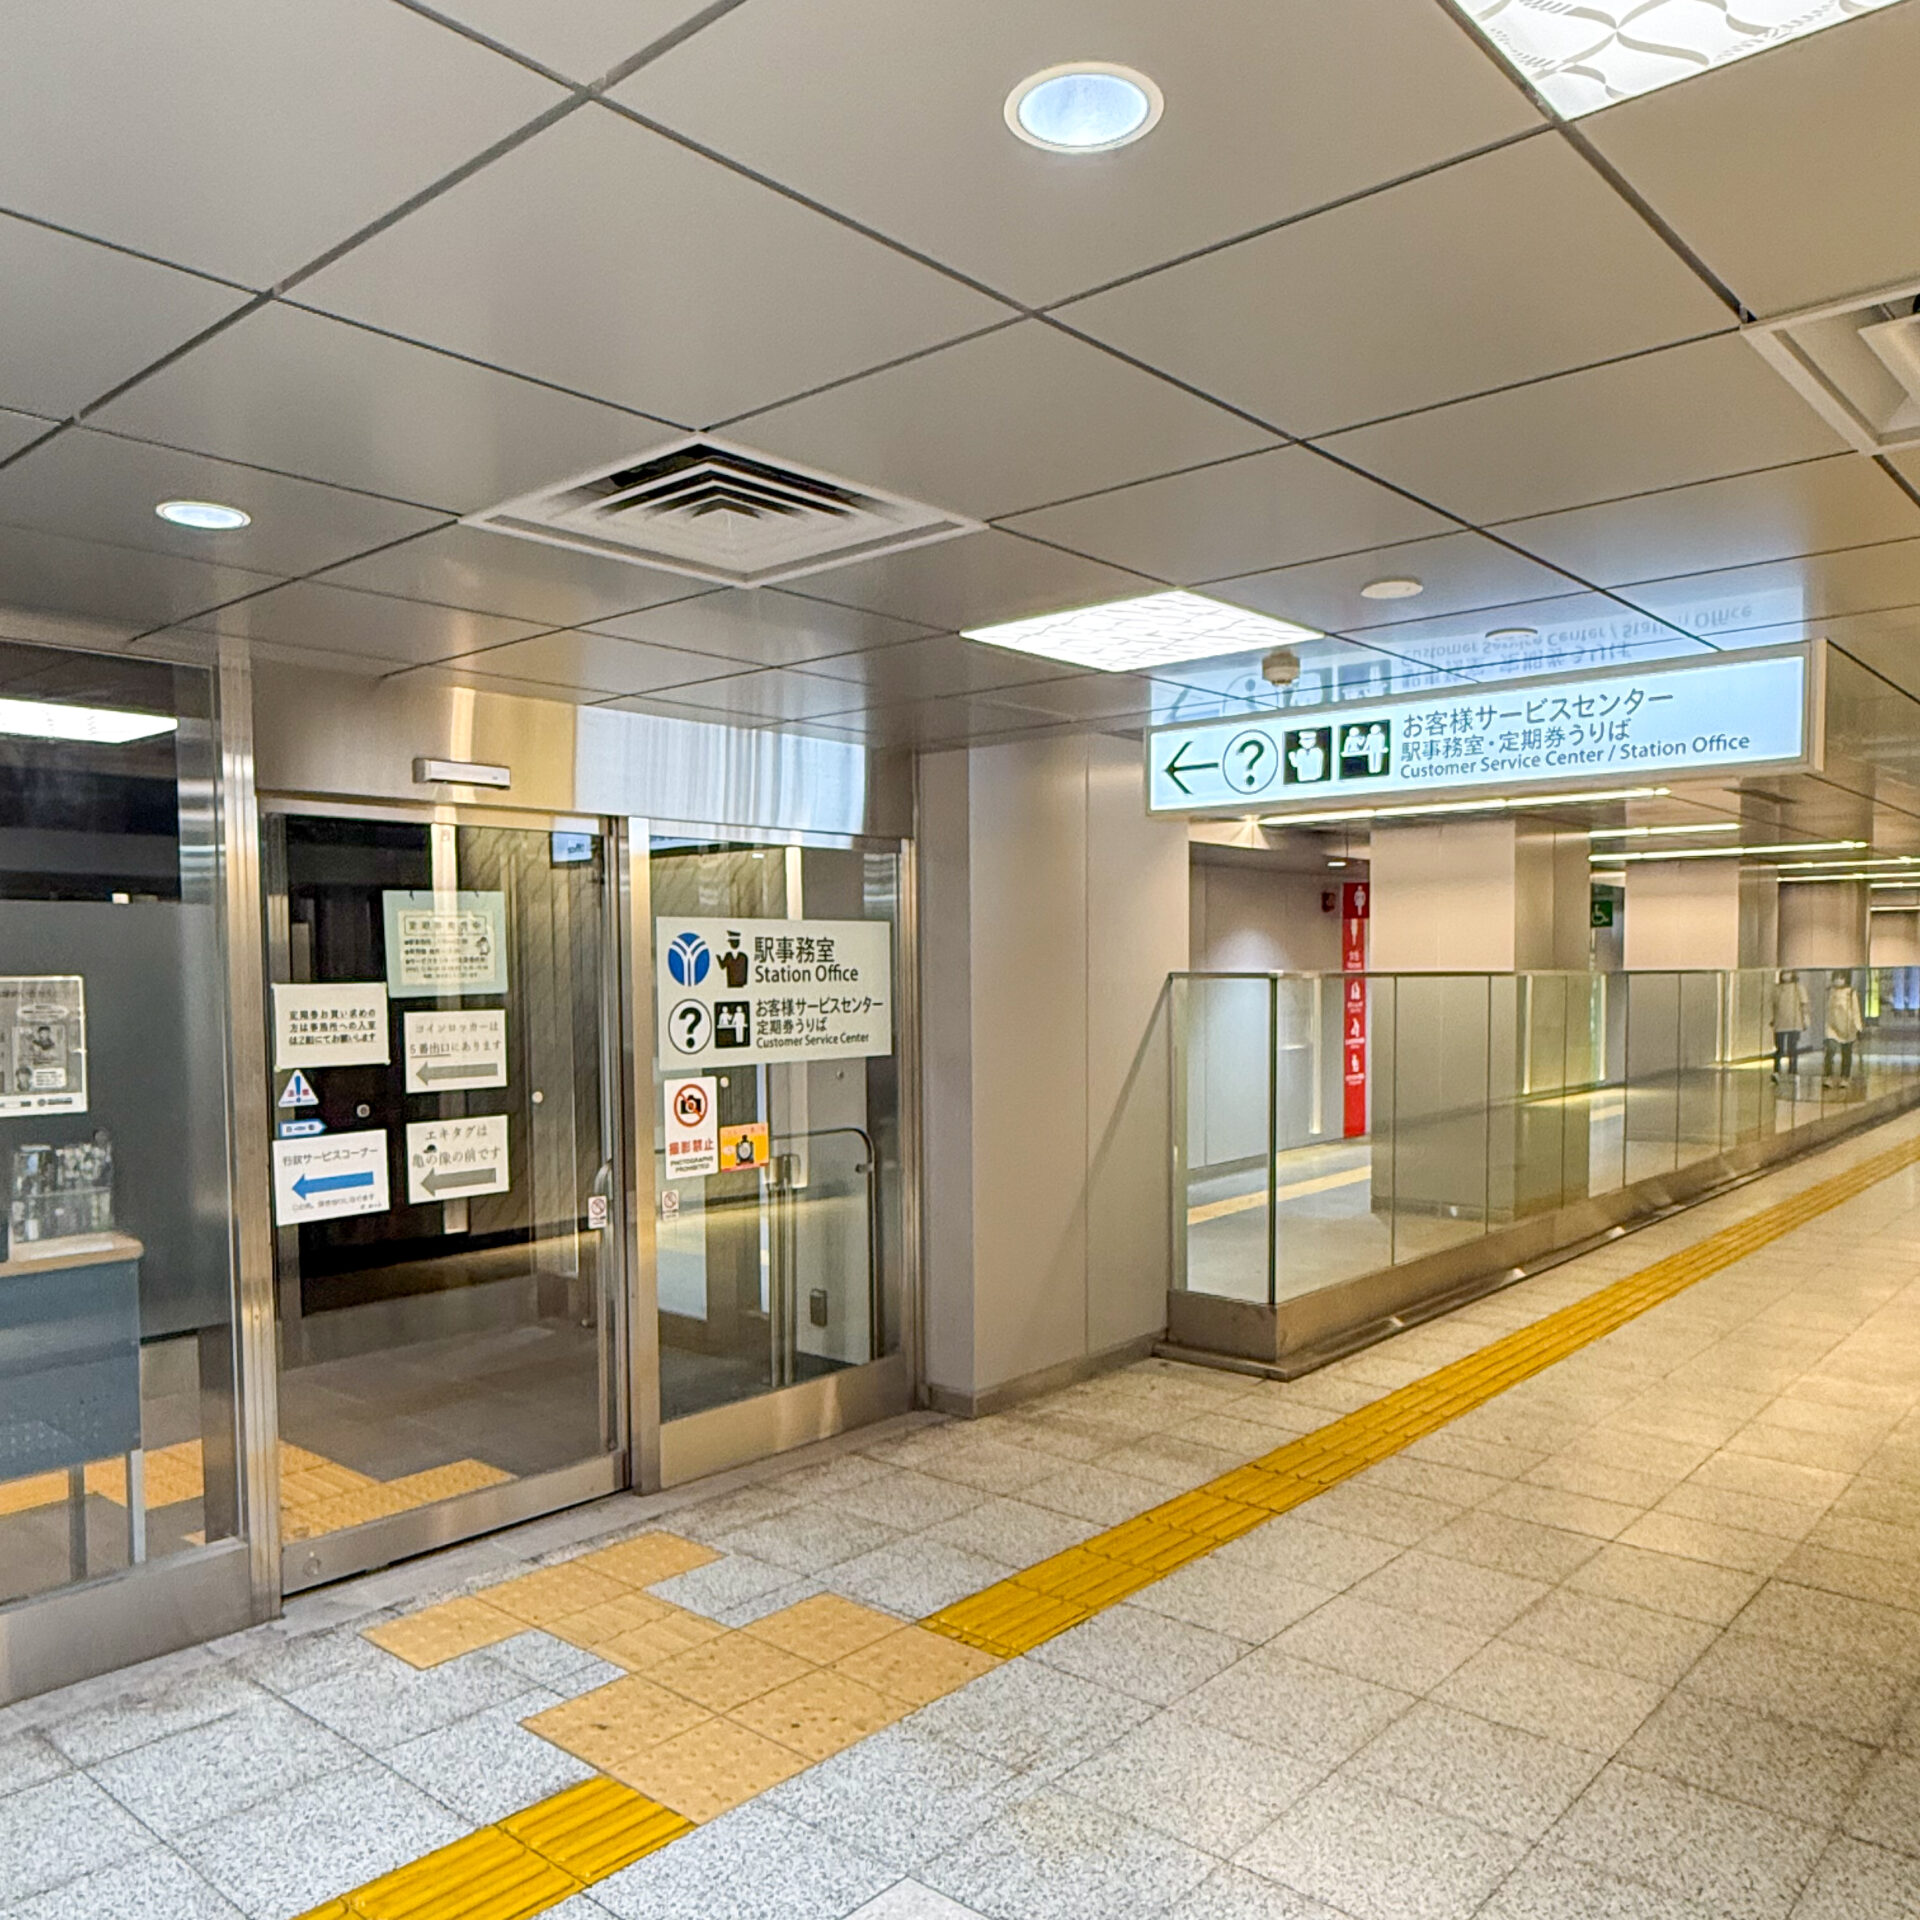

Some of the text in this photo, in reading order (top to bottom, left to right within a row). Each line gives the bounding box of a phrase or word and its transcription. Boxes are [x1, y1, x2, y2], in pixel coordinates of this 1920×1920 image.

[1403, 688, 1674, 738] お客様サービスセンター
[1400, 719, 1631, 761] 駅事務室・定期券うりば
[1400, 733, 1750, 780] Customer Service Center / Station Office
[754, 936, 835, 963] 駅事務室
[755, 964, 858, 983] Station Office
[756, 997, 883, 1017] お客様サービスセンター
[415, 1022, 498, 1033] コインロッカーは
[756, 1018, 827, 1035] 定期券うりば
[756, 1033, 869, 1049] Customer Service Center
[425, 1126, 487, 1141] エキタグは
[669, 1139, 714, 1155] 撮影禁止
[283, 1147, 378, 1167] 行政サービスコーナー
